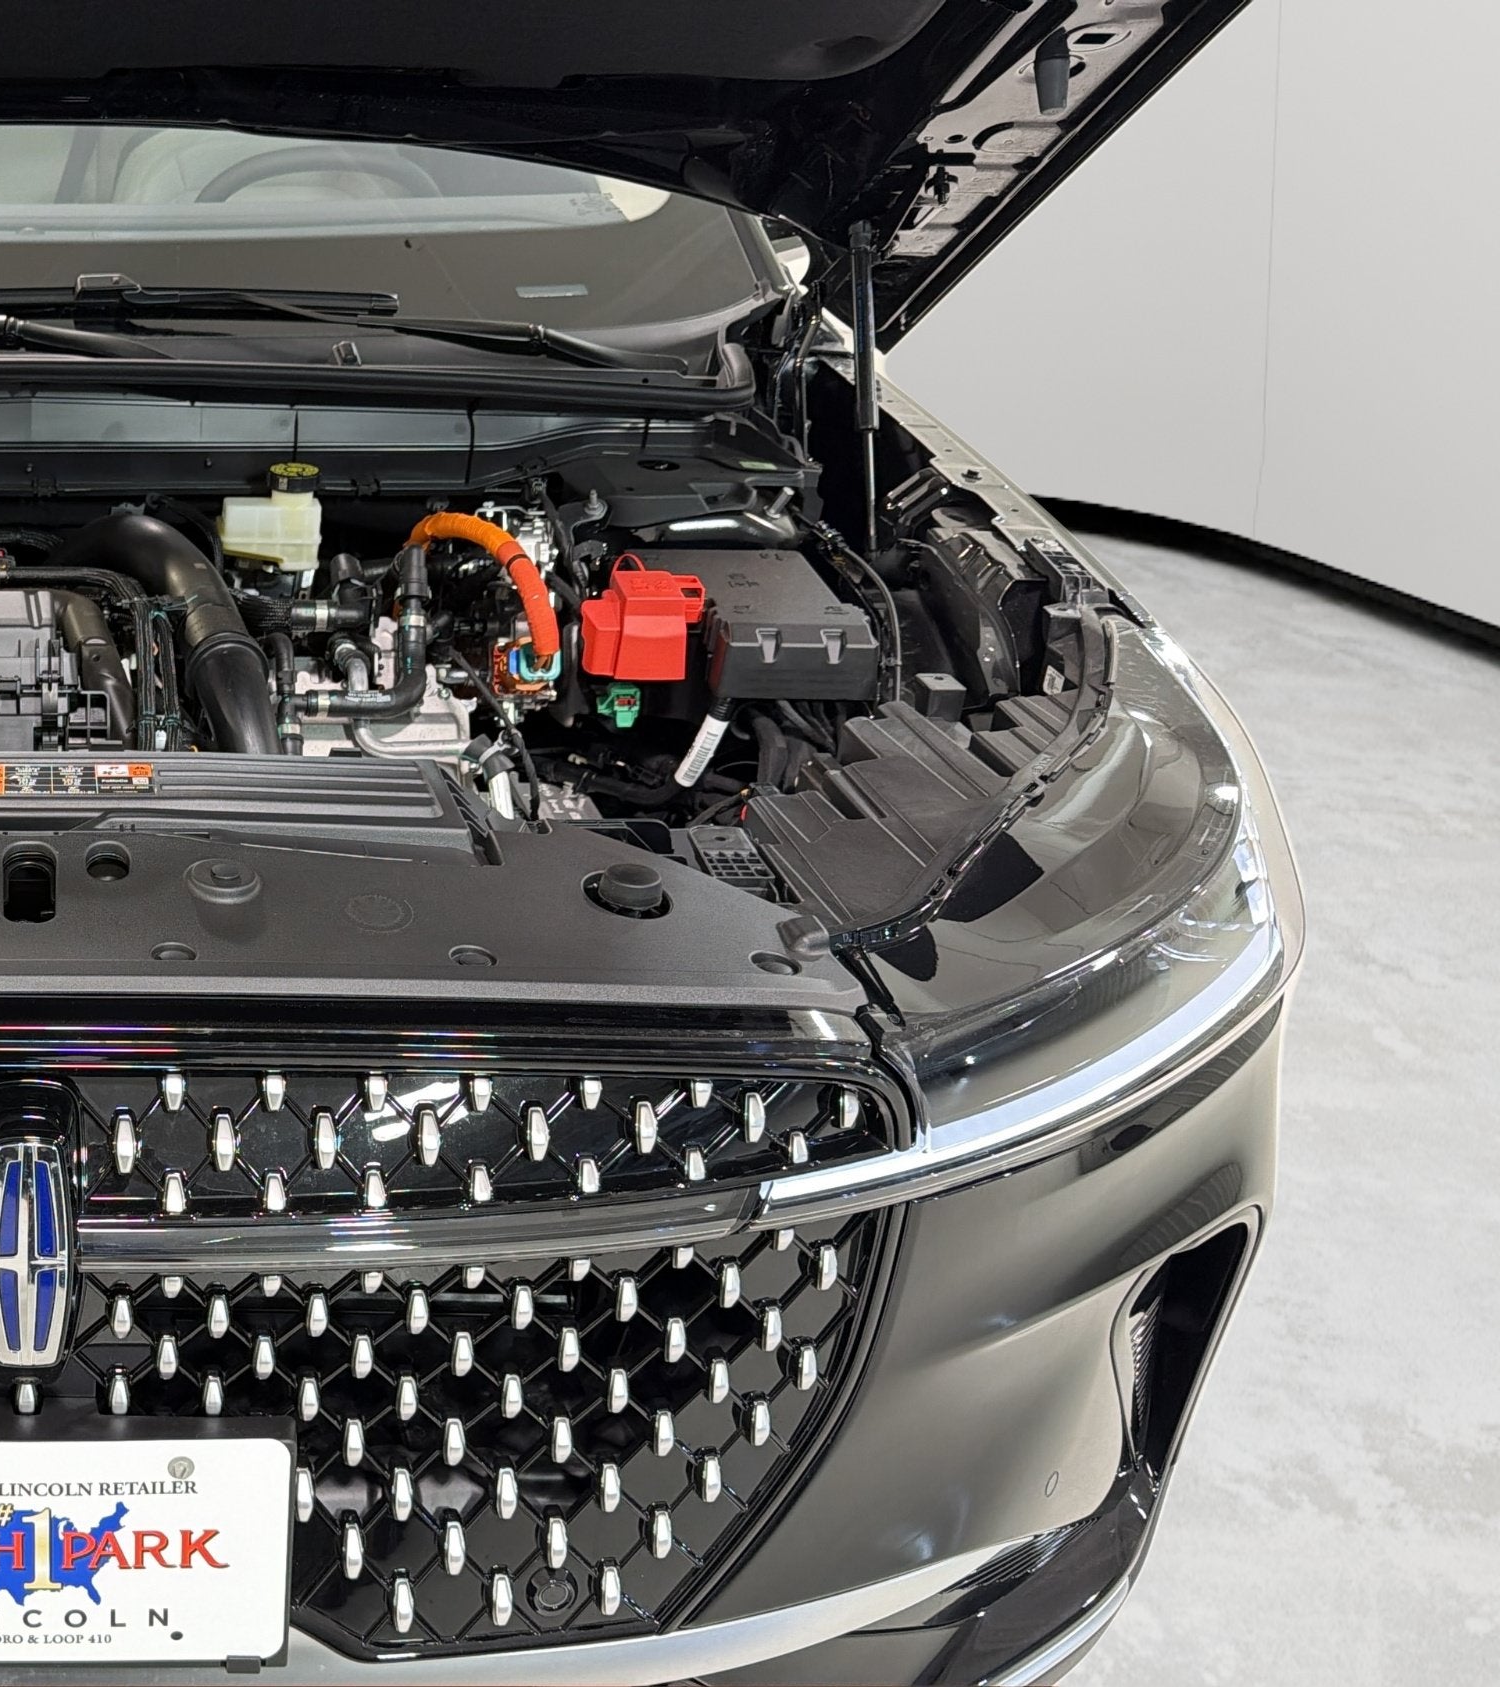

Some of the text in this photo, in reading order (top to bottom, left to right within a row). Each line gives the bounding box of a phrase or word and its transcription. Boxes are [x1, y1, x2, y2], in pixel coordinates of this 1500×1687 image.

[98, 1480, 198, 1496] RETAILER
[61, 1528, 231, 1570] PARK
[27, 1634, 39, 1645] &
[43, 1634, 84, 1645] LOOP
[88, 1633, 112, 1645] 410
